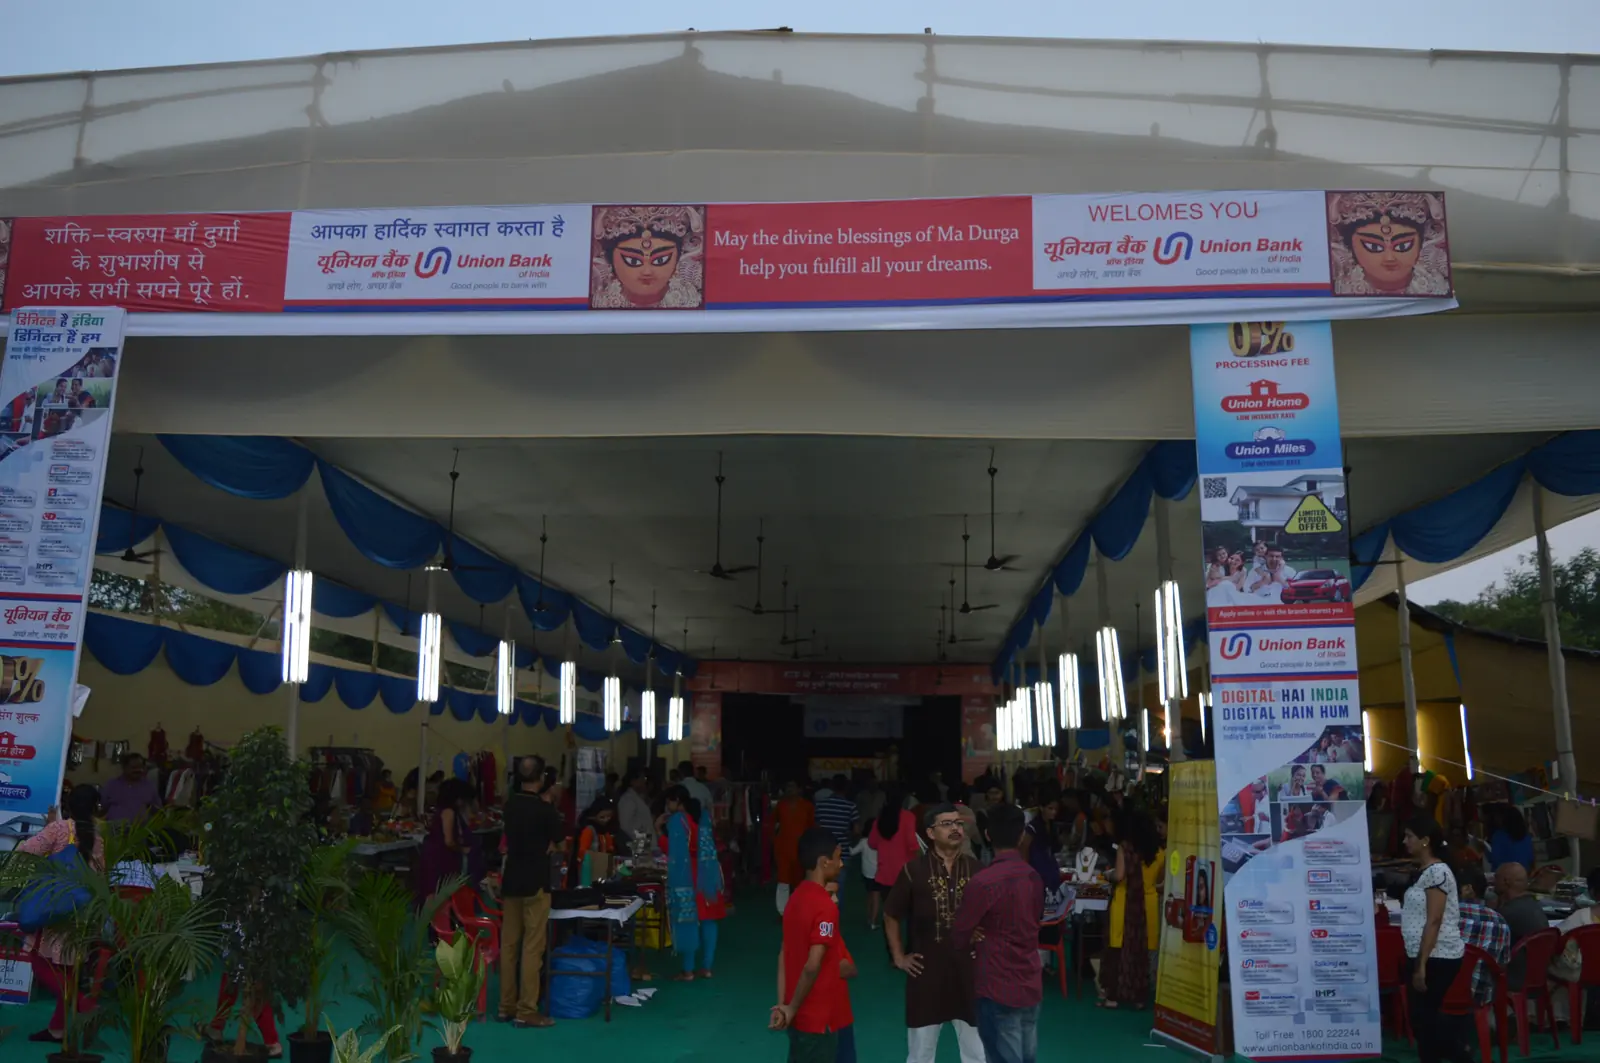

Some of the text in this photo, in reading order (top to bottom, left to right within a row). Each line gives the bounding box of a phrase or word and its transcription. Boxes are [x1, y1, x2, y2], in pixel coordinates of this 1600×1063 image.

[1088, 201, 1259, 222] WELOMES YOU
[174, 220, 198, 242] माँ
[204, 220, 240, 248] दुर्गा
[310, 214, 566, 240] आपका हार्दिक स्वागत करता है
[713, 224, 1019, 250] May the divine blessings of Ma Durga
[1043, 235, 1148, 262] यूनियन बैंक
[1199, 238, 1303, 254] Union Bank
[71, 248, 206, 277] के शुभाशीष से
[317, 248, 411, 273] यूनियन बैंक
[456, 253, 552, 268] Union Bank
[1267, 254, 1302, 263] of India
[518, 270, 550, 278] of India
[739, 254, 993, 279] help you fulfill all your dreams.
[1195, 268, 1218, 277] Good
[1219, 268, 1248, 277] people
[1250, 267, 1259, 275] to
[1282, 266, 1300, 274] with
[22, 277, 82, 299] आपके
[89, 278, 130, 299] सभी
[137, 276, 181, 298] सपने
[188, 276, 213, 305] पूरे
[450, 281, 548, 291] Good people to bank with
[16, 311, 105, 328] डिजिटल है इंडिया
[14, 329, 63, 342] डिजिटल
[81, 333, 102, 344] हम
[1216, 358, 1310, 369] PROCESSING FEE
[1228, 398, 1302, 409] Union Home
[1235, 444, 1306, 455] Union Miles
[1299, 509, 1326, 517] LIMITED
[1299, 523, 1328, 531] OFFER
[4, 605, 73, 625] यूनियन बैंक
[1219, 610, 1236, 618] Apply
[1309, 607, 1331, 615] nearest
[1258, 637, 1346, 651] Union Bank
[1327, 650, 1346, 658] India
[1222, 688, 1348, 703] DIGITAL HAI INDIA
[16, 712, 40, 724] शुल्क
[1223, 705, 1349, 720] DIGITAL HAIN HUM
[819, 921, 834, 938] 91
[1255, 1029, 1360, 1039] Toll Free 1800 222244
